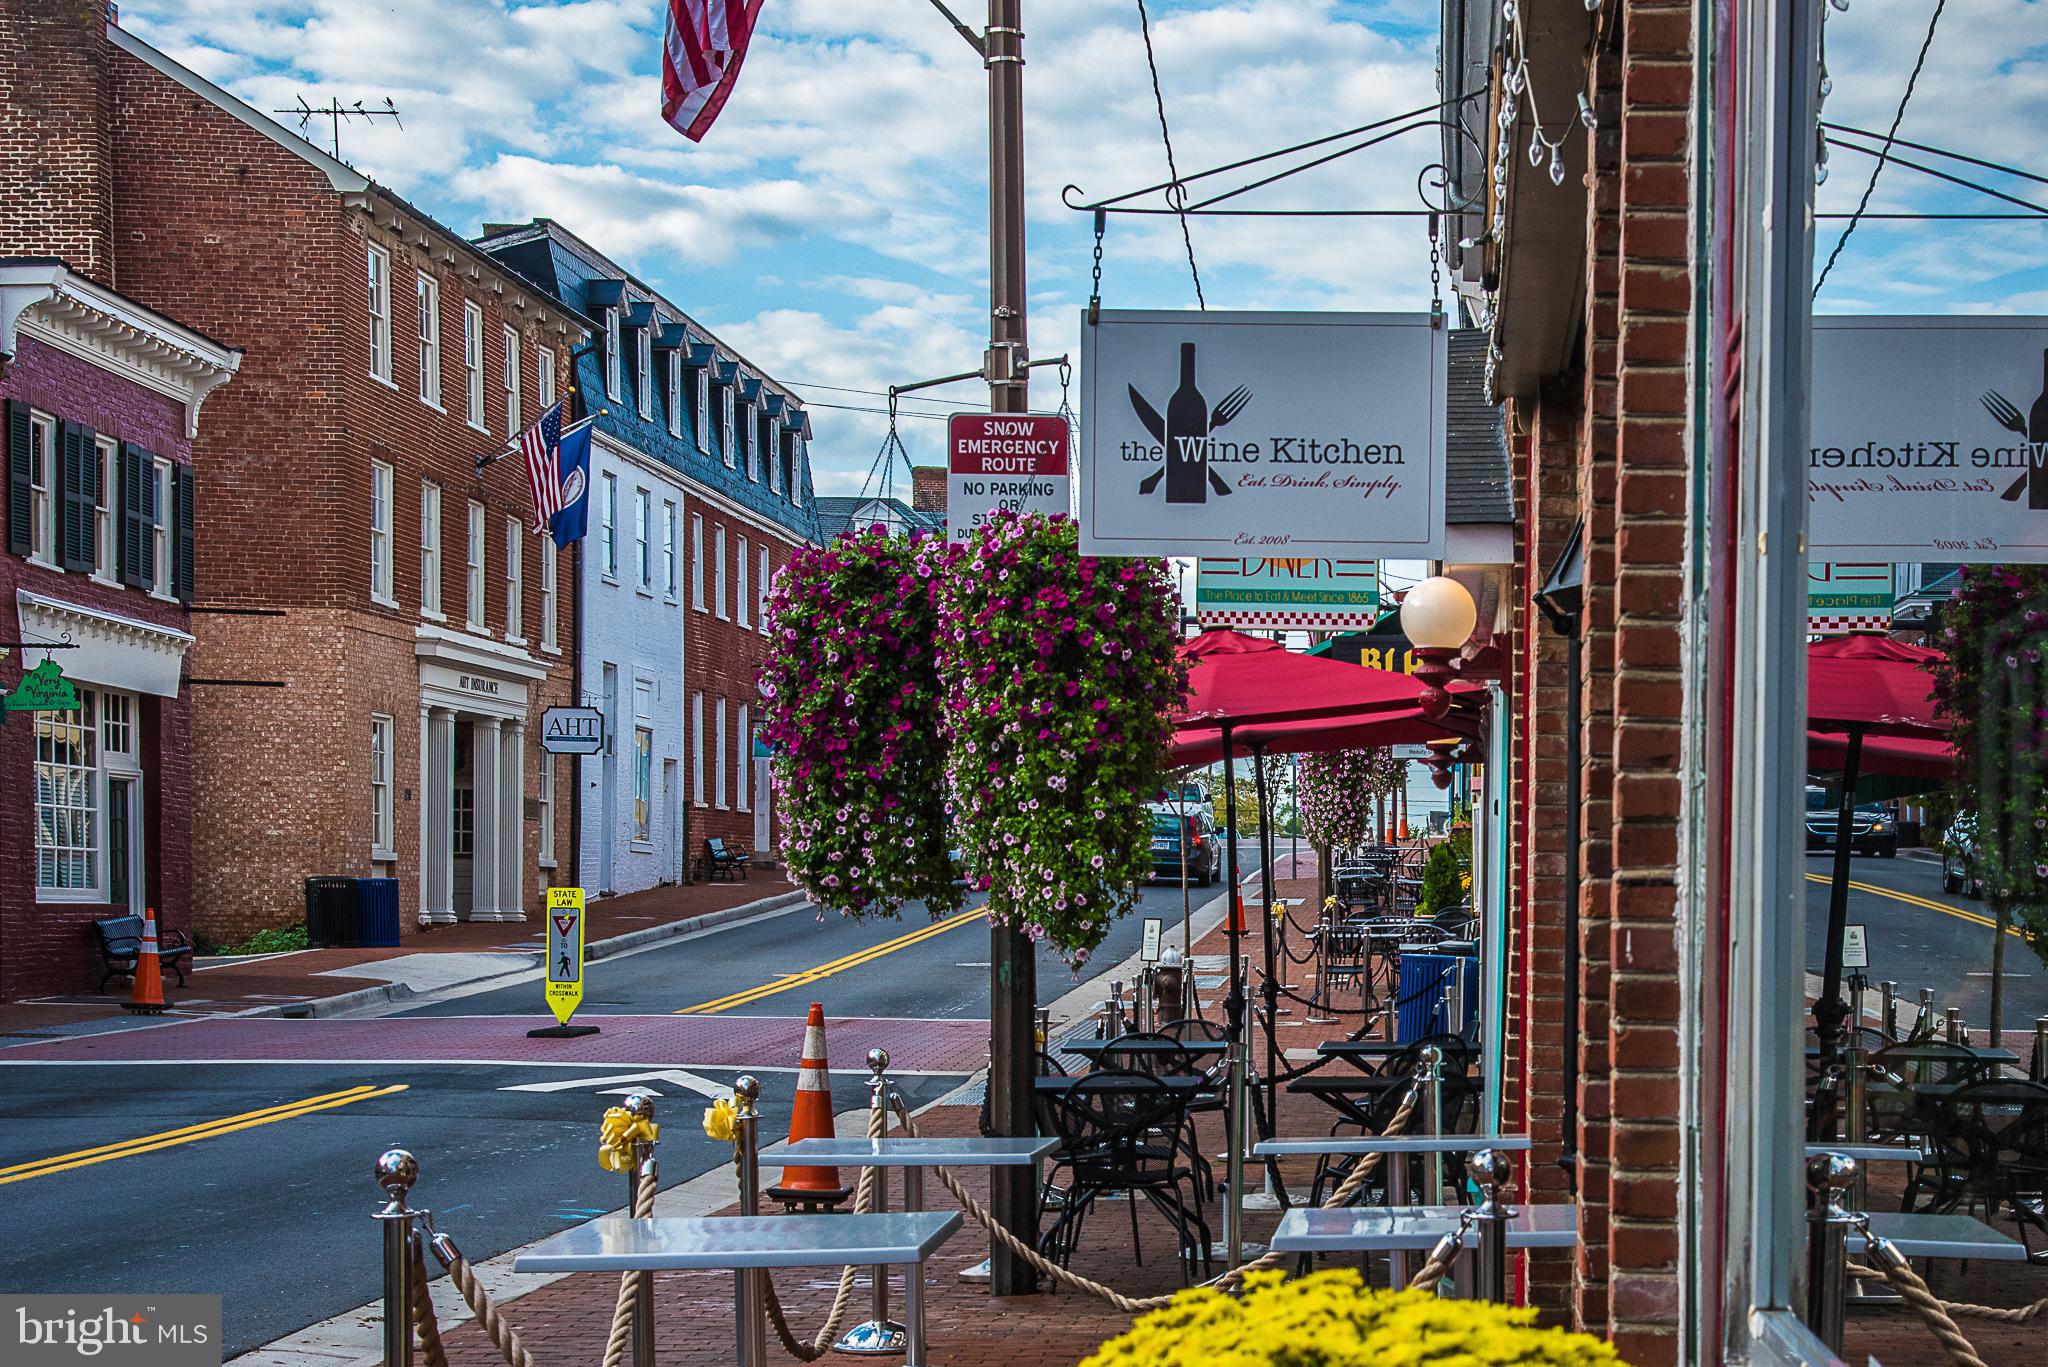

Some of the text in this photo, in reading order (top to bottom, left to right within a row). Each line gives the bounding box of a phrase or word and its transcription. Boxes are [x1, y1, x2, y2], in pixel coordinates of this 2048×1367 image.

[983, 421, 1034, 436] SNOW
[958, 439, 1059, 455] EMERGENCY
[1120, 436, 1405, 465] the Wine Kitchen
[981, 457, 1036, 472] ROUTE
[963, 482, 1055, 497] NO PARKING
[1238, 471, 1403, 499] Eat, Drink, Simply.
[998, 499, 1019, 511] OR
[1234, 532, 1291, 546] Est. 2008
[1206, 589, 1369, 604] The Place to Eat & Meet Since 1865
[33, 672, 60, 689] Very
[459, 675, 499, 695] AHT INSURANCE
[25, 685, 67, 700] Virginia
[547, 717, 599, 736] AHT
[553, 890, 577, 898] STATE
[556, 899, 573, 907] LAW
